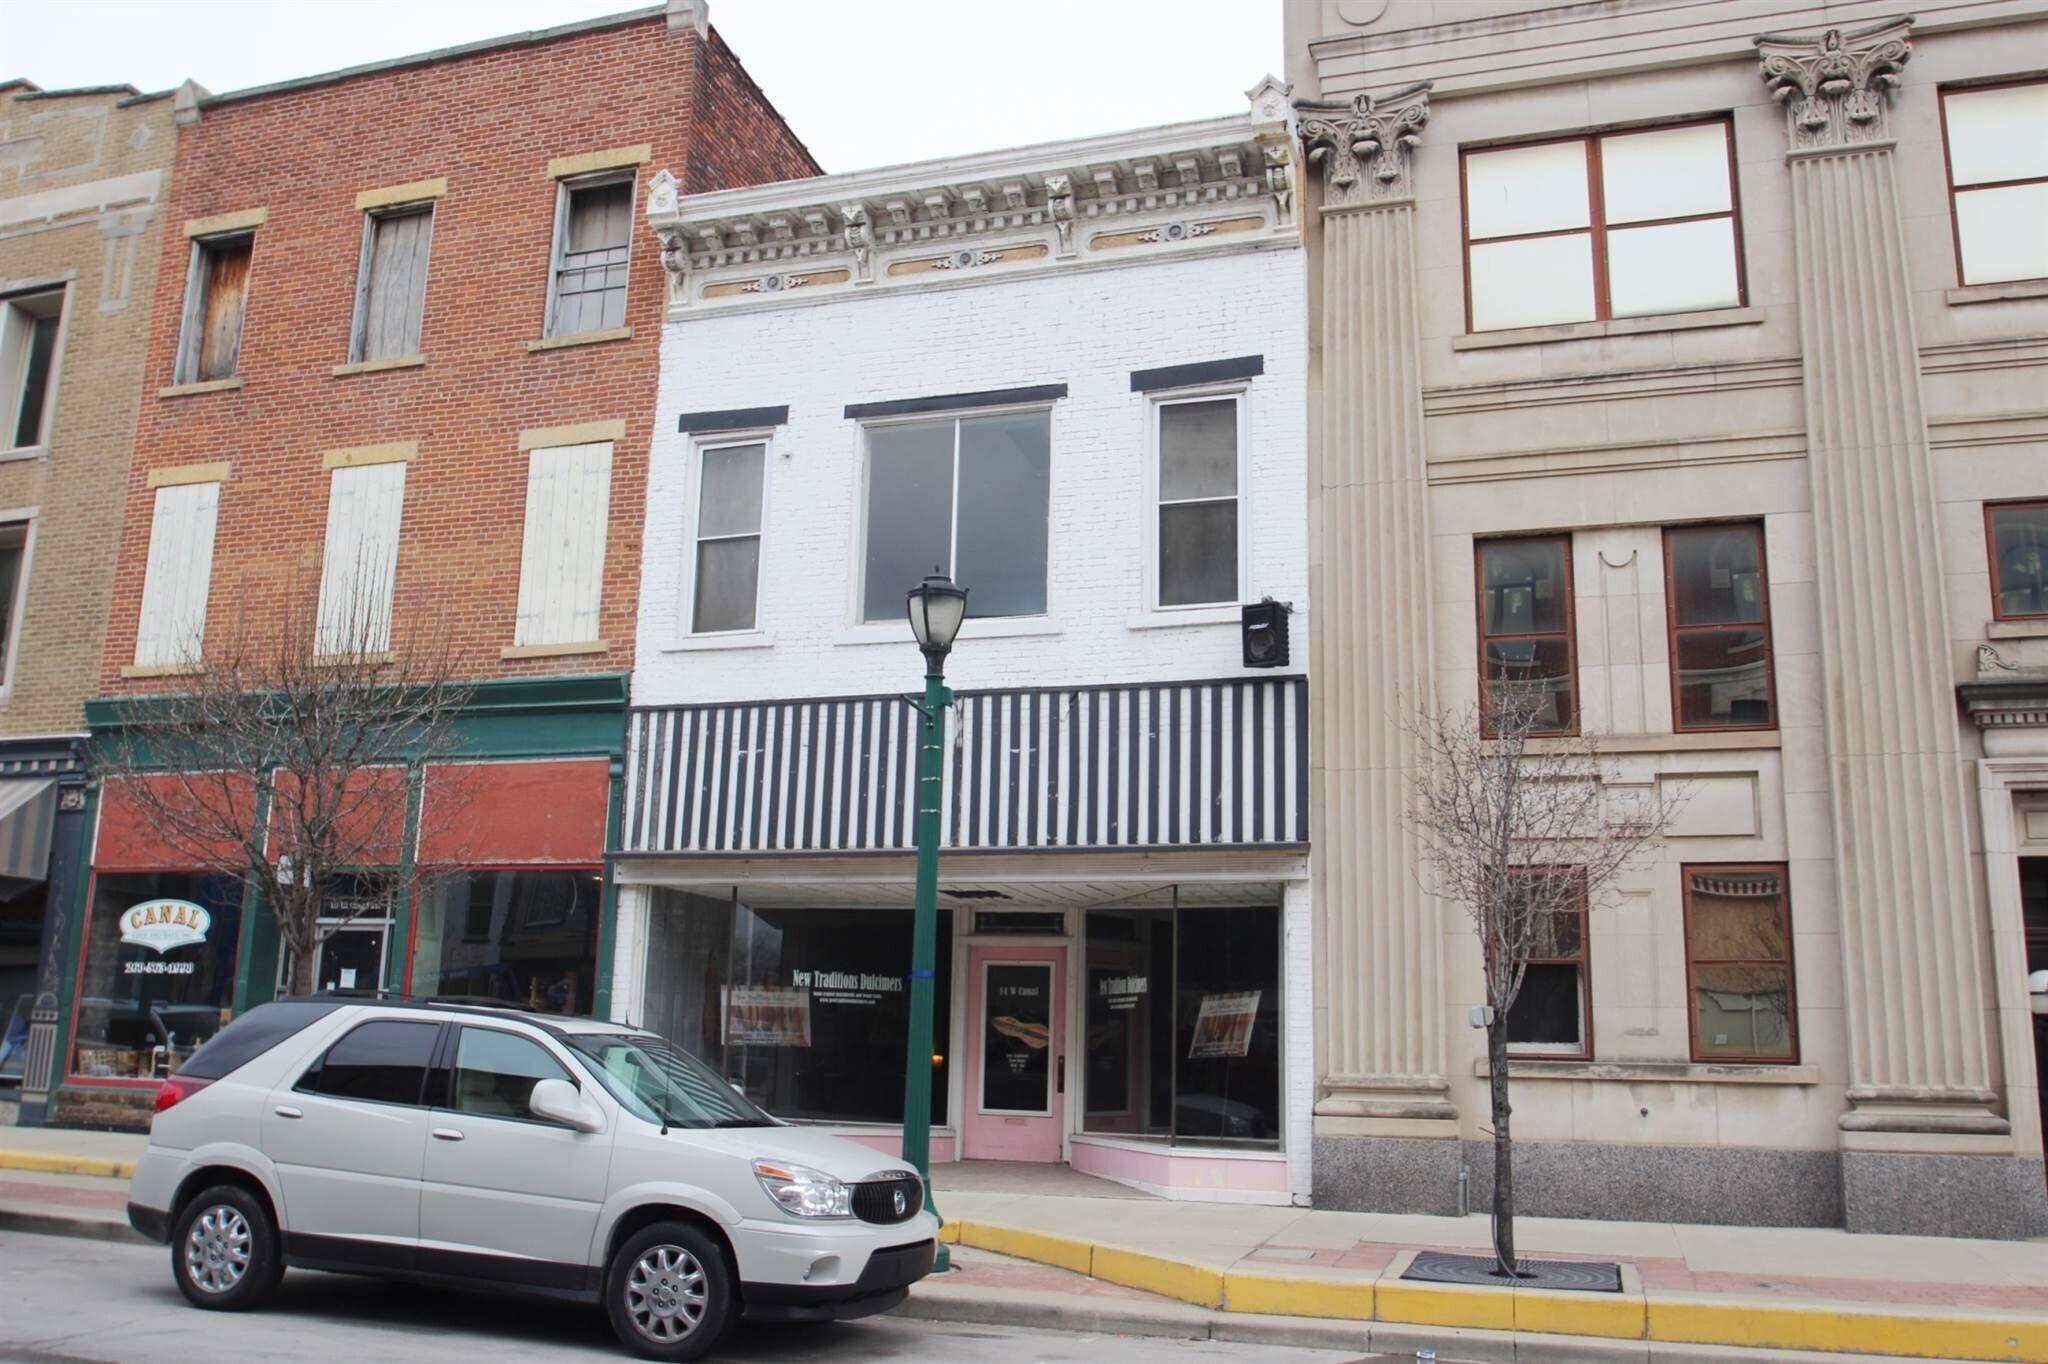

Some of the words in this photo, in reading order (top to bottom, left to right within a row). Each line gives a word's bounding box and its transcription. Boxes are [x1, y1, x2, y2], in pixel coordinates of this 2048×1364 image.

[130, 904, 200, 929] CANAL
[792, 969, 812, 987] New
[814, 970, 858, 990] Traditions
[860, 973, 903, 992] Dulcimers
